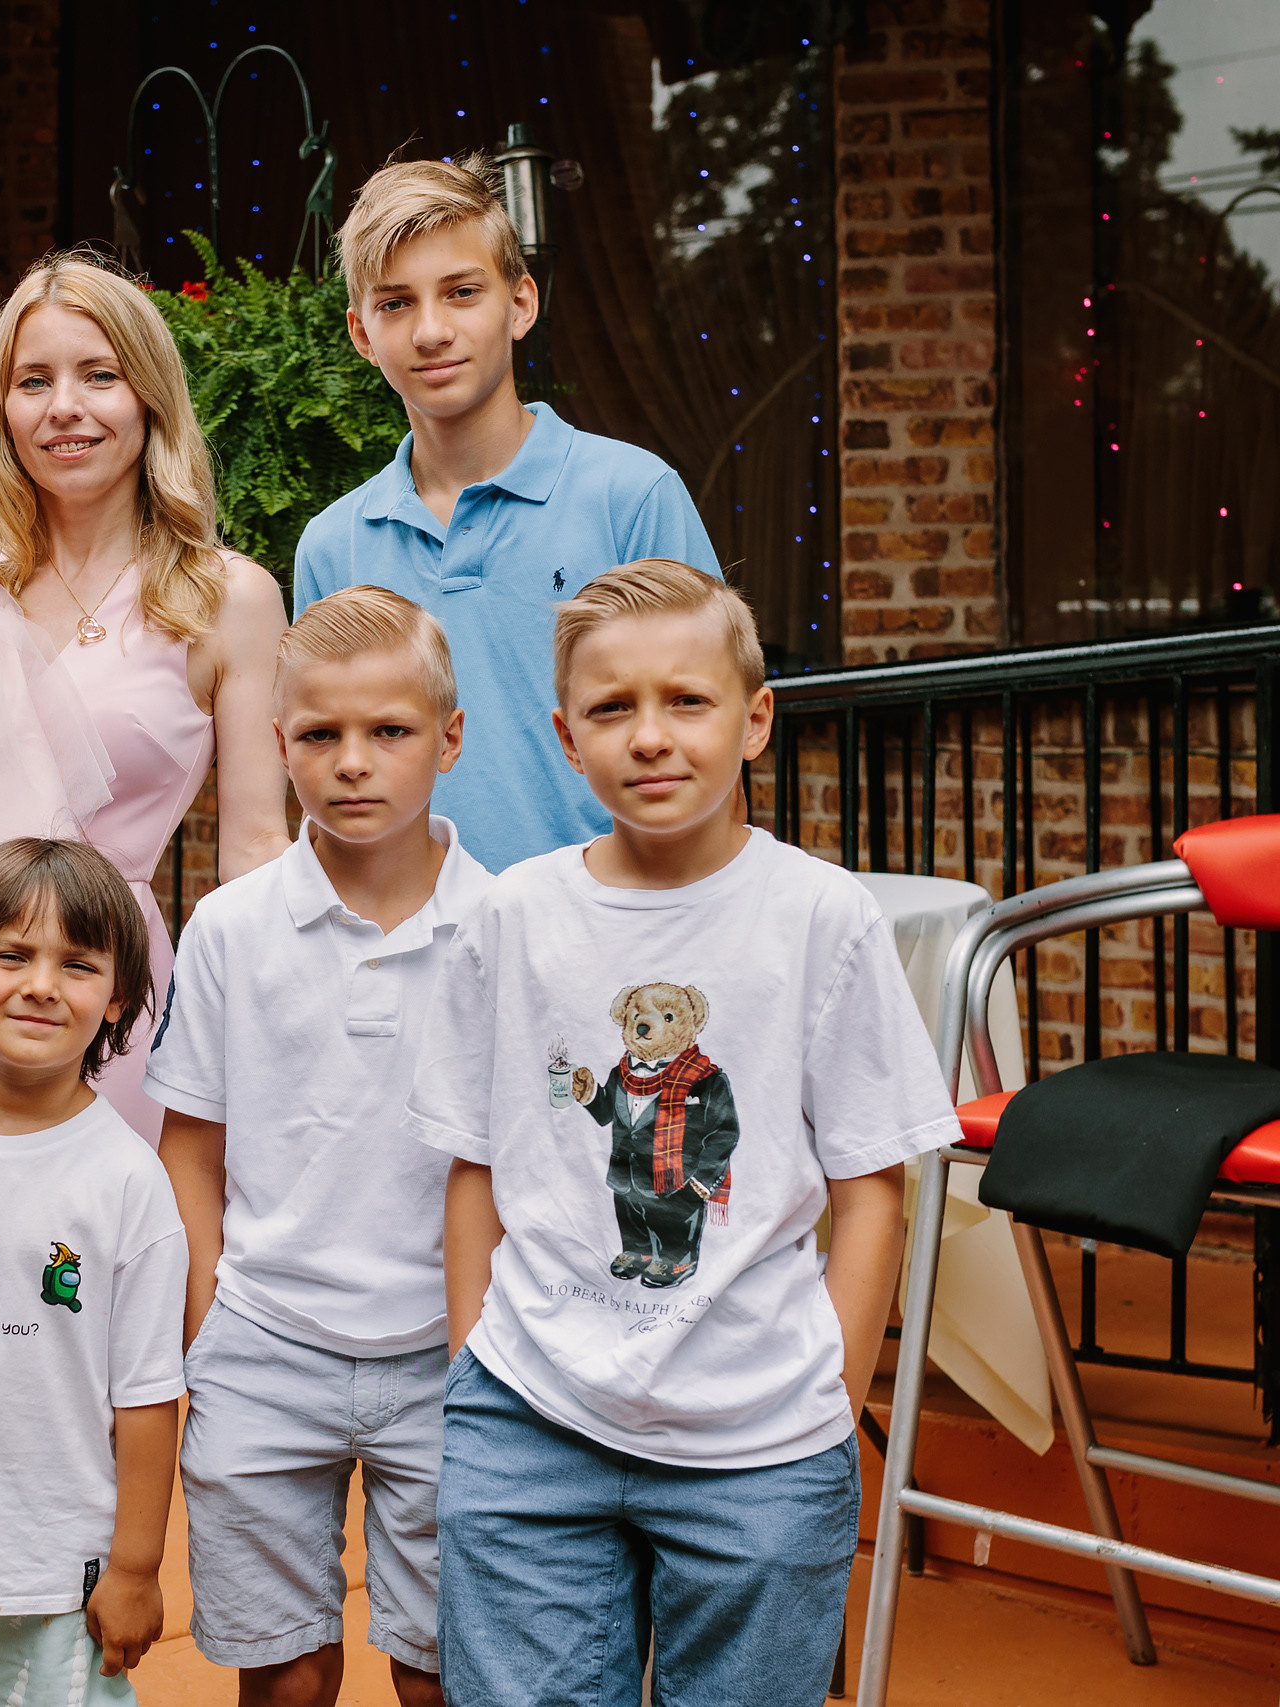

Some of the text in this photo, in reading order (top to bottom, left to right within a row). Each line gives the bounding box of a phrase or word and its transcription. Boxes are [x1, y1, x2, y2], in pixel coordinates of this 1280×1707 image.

[542, 1284, 568, 1297] OLO
[572, 1286, 606, 1304] BEAR
[610, 1295, 621, 1311] by
[625, 1300, 671, 1316] RALPH
[1, 1322, 40, 1337] you?
